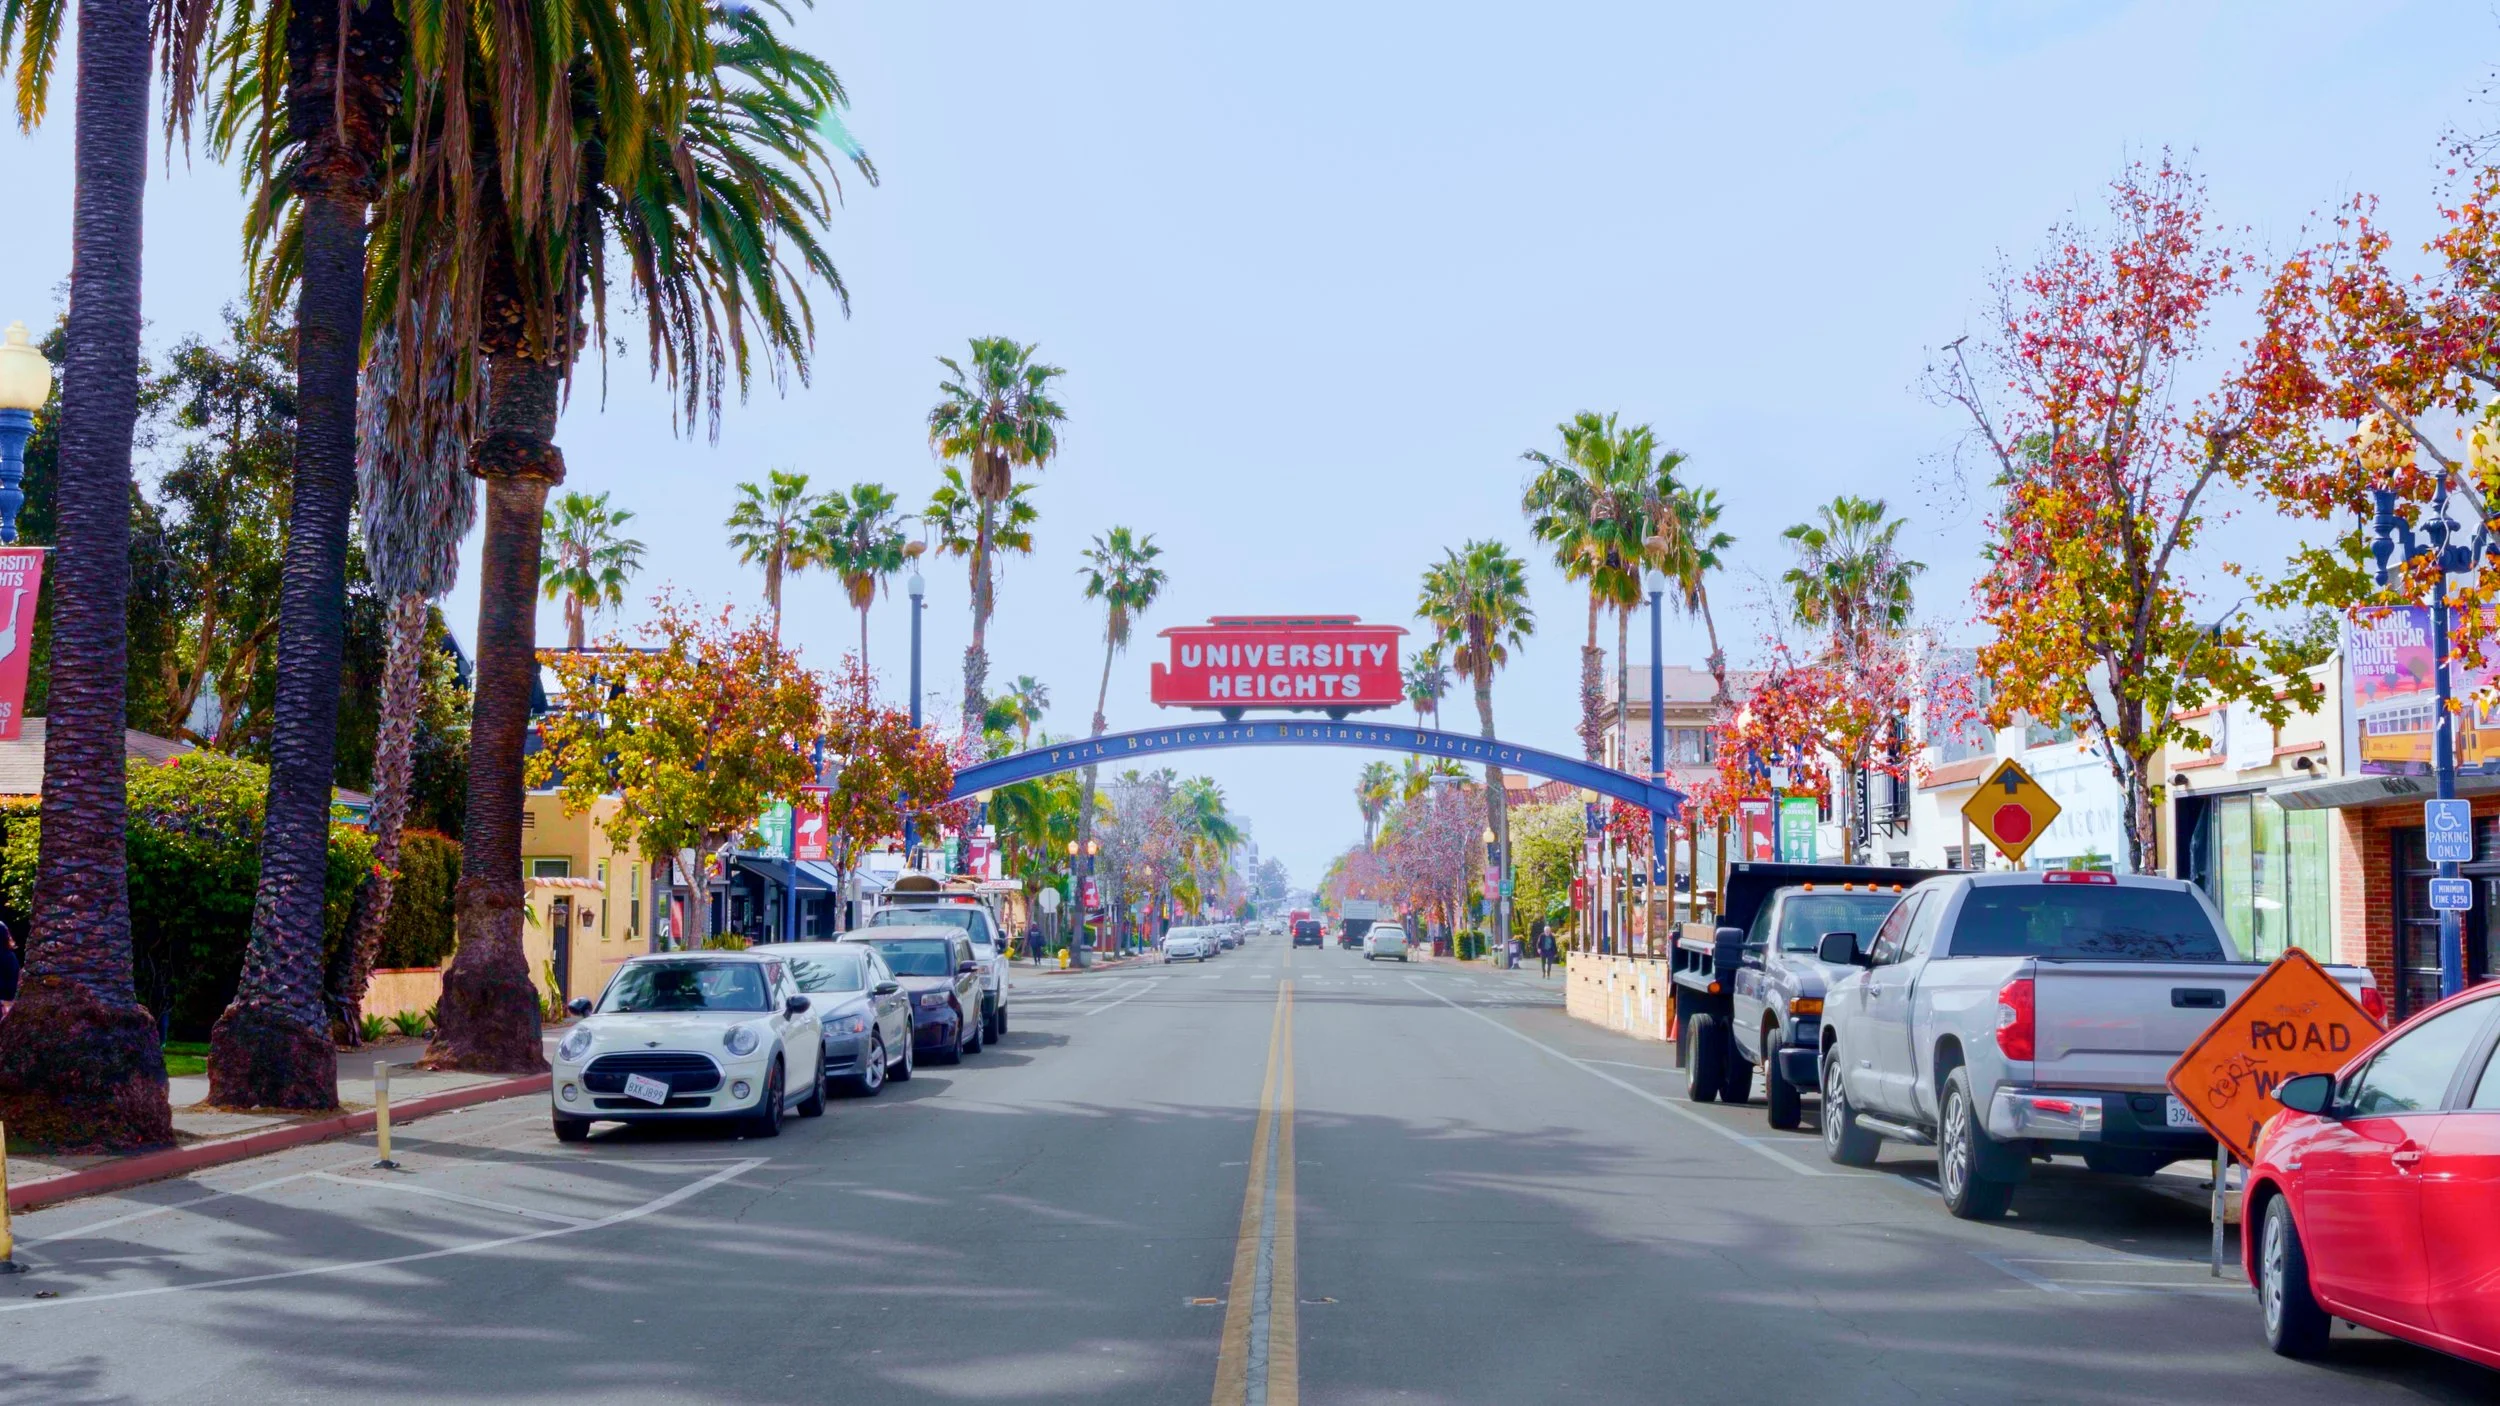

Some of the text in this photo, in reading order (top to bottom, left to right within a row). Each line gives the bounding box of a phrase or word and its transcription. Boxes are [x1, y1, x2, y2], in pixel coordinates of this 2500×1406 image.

[2351, 628, 2425, 648] STREETCAR
[1181, 643, 1388, 668] UNIVERSITY
[2352, 647, 2398, 666] ROUTE
[1209, 674, 1361, 698] HEIGHTS
[1051, 724, 1523, 764] Park Boulevard Business District
[2429, 831, 2469, 844] PARKING
[2437, 845, 2461, 857] ONLY
[2438, 885, 2465, 893] MINIMUM
[2435, 895, 2468, 904] FINE $250
[2251, 1020, 2351, 1052] ROAD
